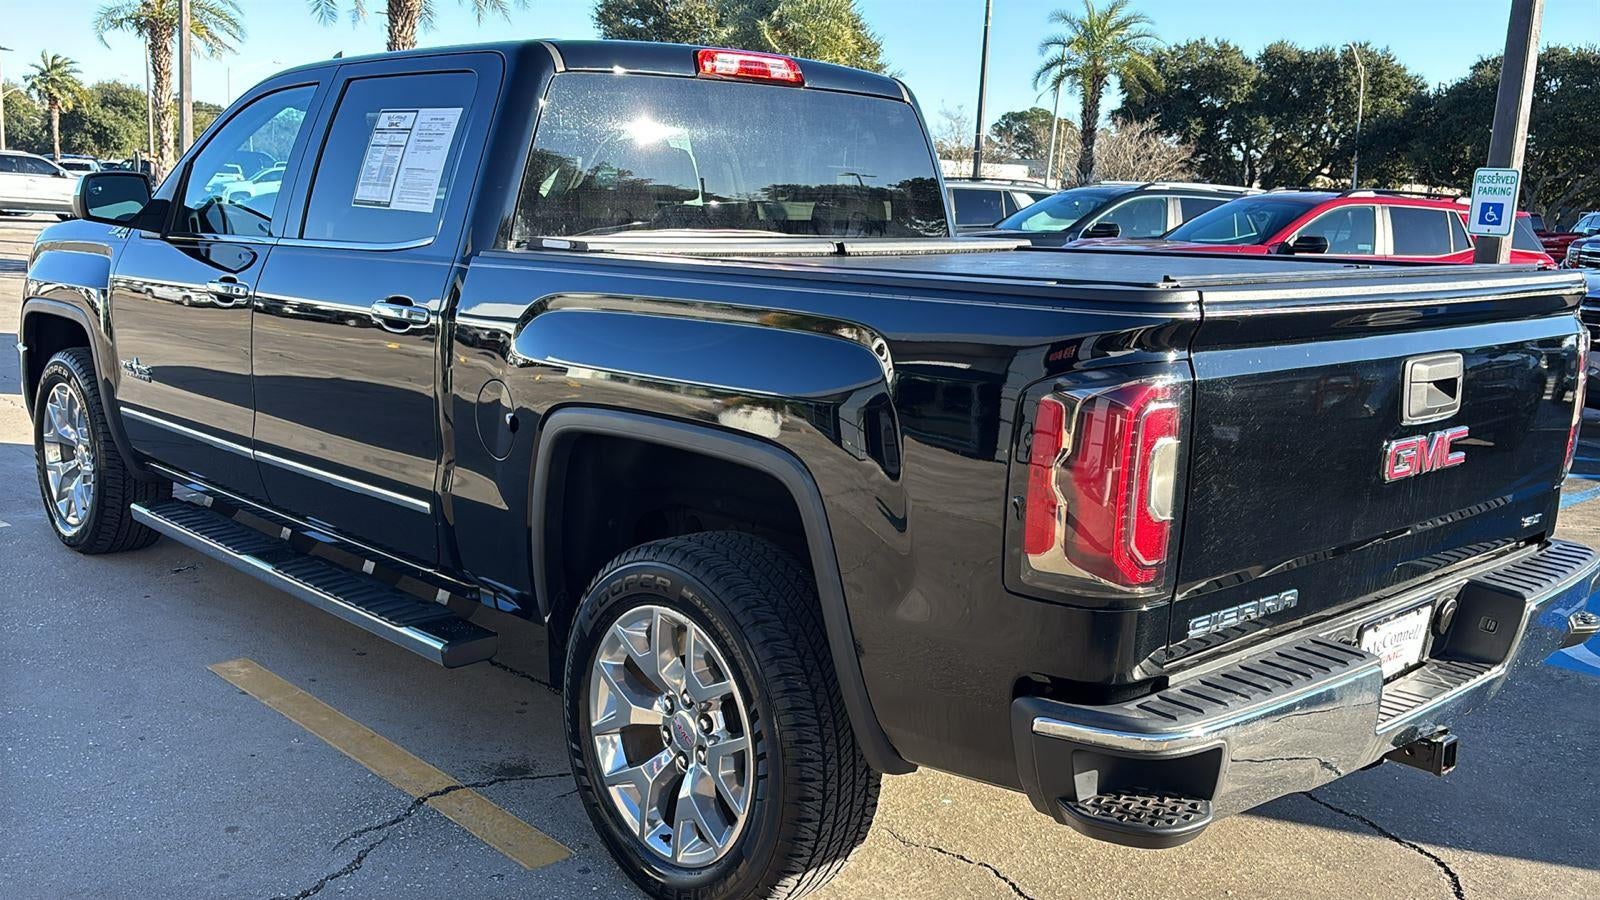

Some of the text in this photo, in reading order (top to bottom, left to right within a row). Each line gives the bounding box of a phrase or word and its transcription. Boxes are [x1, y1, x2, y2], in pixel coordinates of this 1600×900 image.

[1477, 175, 1515, 184] RESERVED
[1478, 186, 1511, 196] PARKING
[1382, 426, 1469, 484] GMC
[588, 573, 672, 620] COOPER
[1187, 589, 1298, 639] SIERRA
